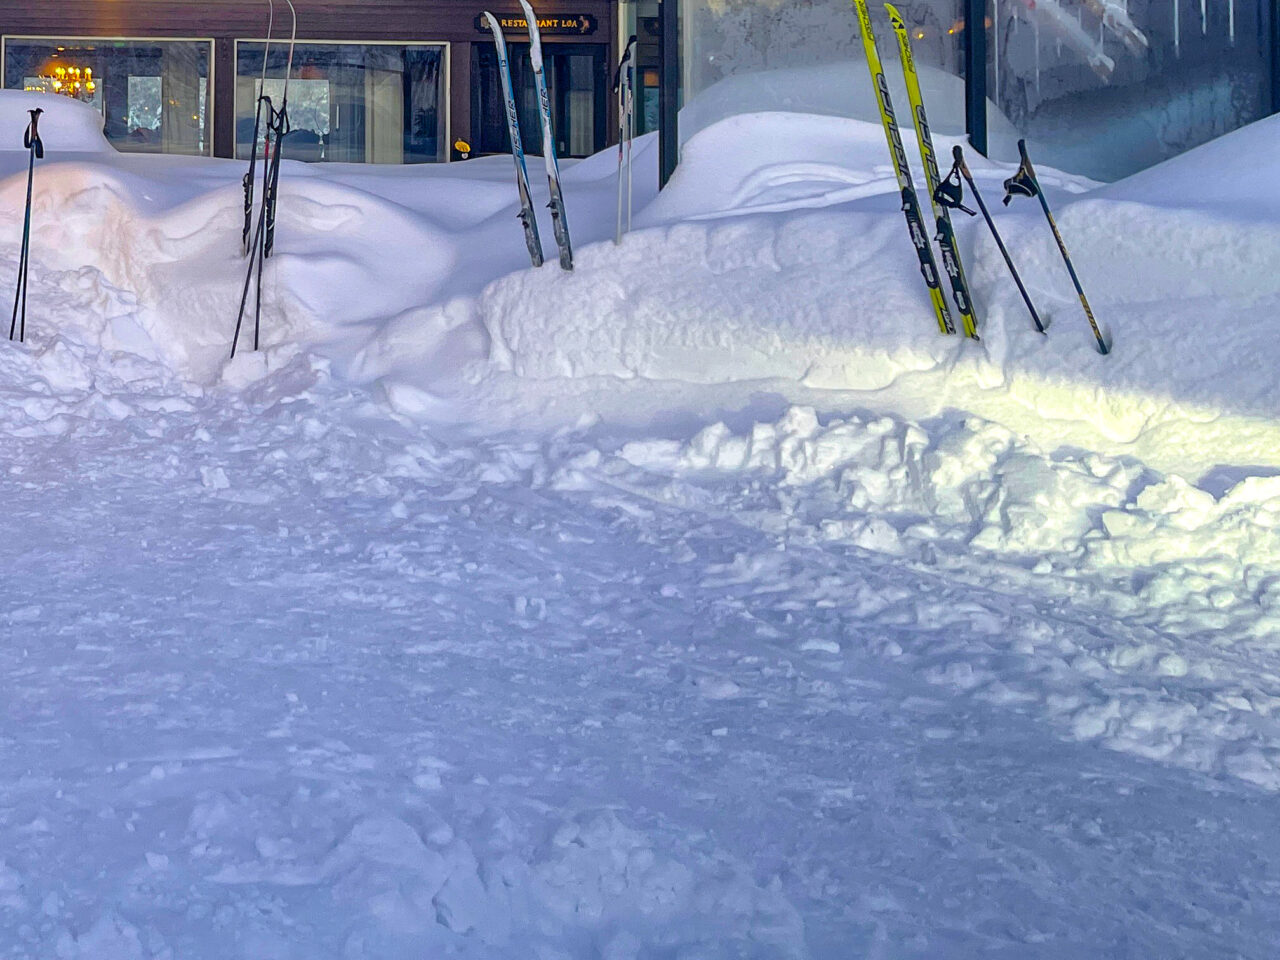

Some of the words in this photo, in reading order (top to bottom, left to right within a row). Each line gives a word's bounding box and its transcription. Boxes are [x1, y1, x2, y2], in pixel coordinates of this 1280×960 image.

[501, 18, 558, 28] RESTAANT
[561, 19, 578, 28] LOA
[507, 100, 522, 160] FISCHER
